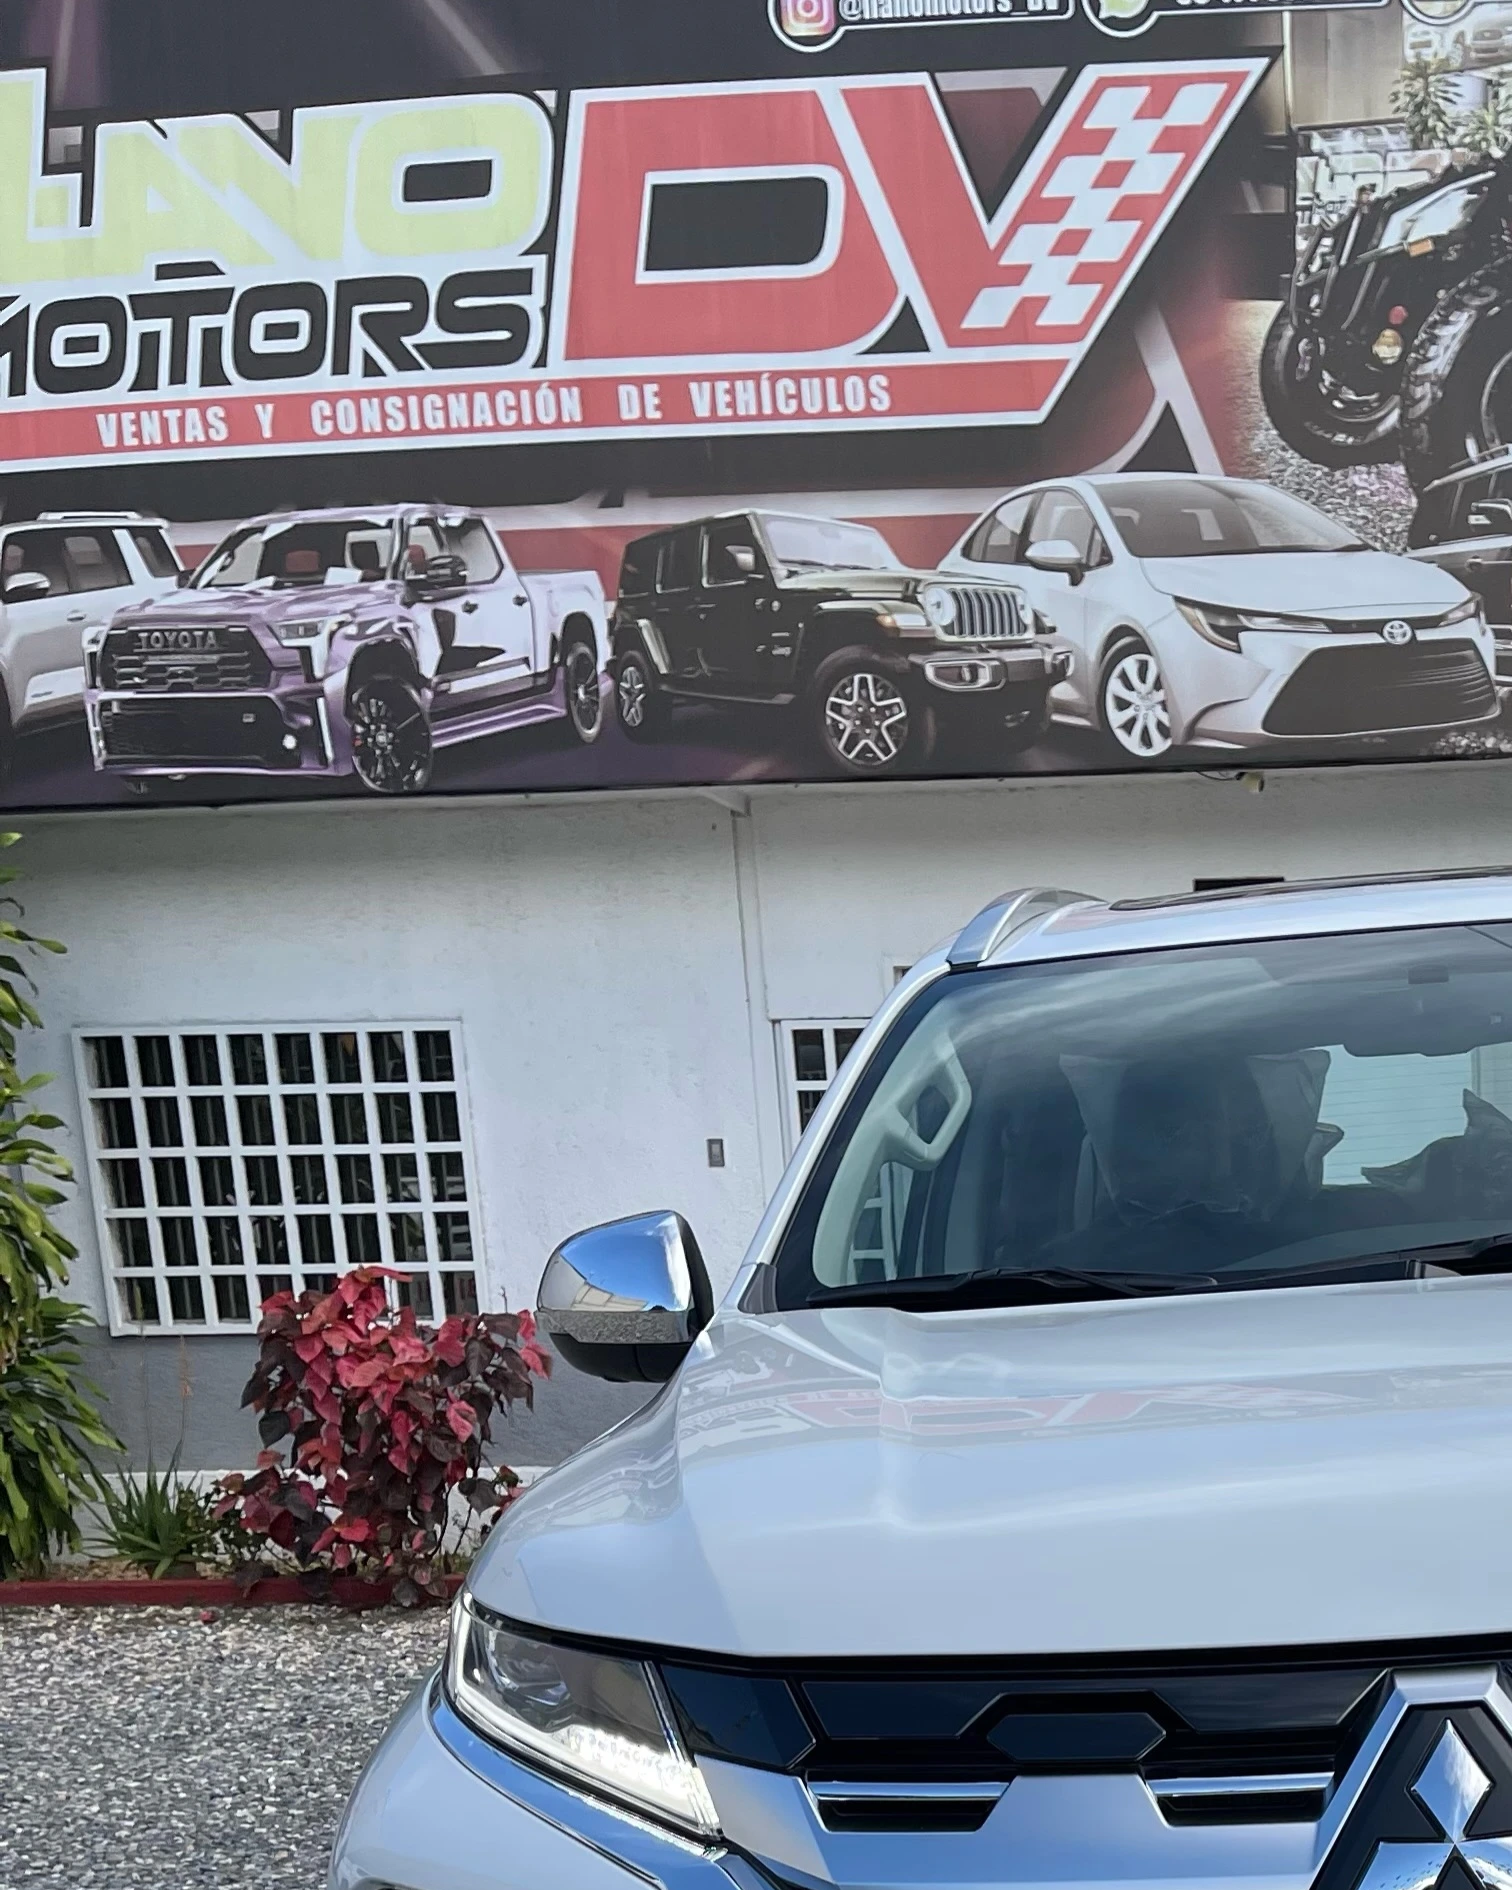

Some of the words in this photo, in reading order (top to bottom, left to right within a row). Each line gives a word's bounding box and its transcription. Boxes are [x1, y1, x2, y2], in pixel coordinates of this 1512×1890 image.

[556, 60, 1265, 358] DV
[96, 405, 229, 448] VENTAS
[254, 403, 274, 438] Y
[310, 381, 583, 437] CONSIGNACIÓN
[616, 383, 663, 420] DE
[688, 373, 892, 417] VEHÍCULOS
[137, 630, 220, 650] TOYOTA
